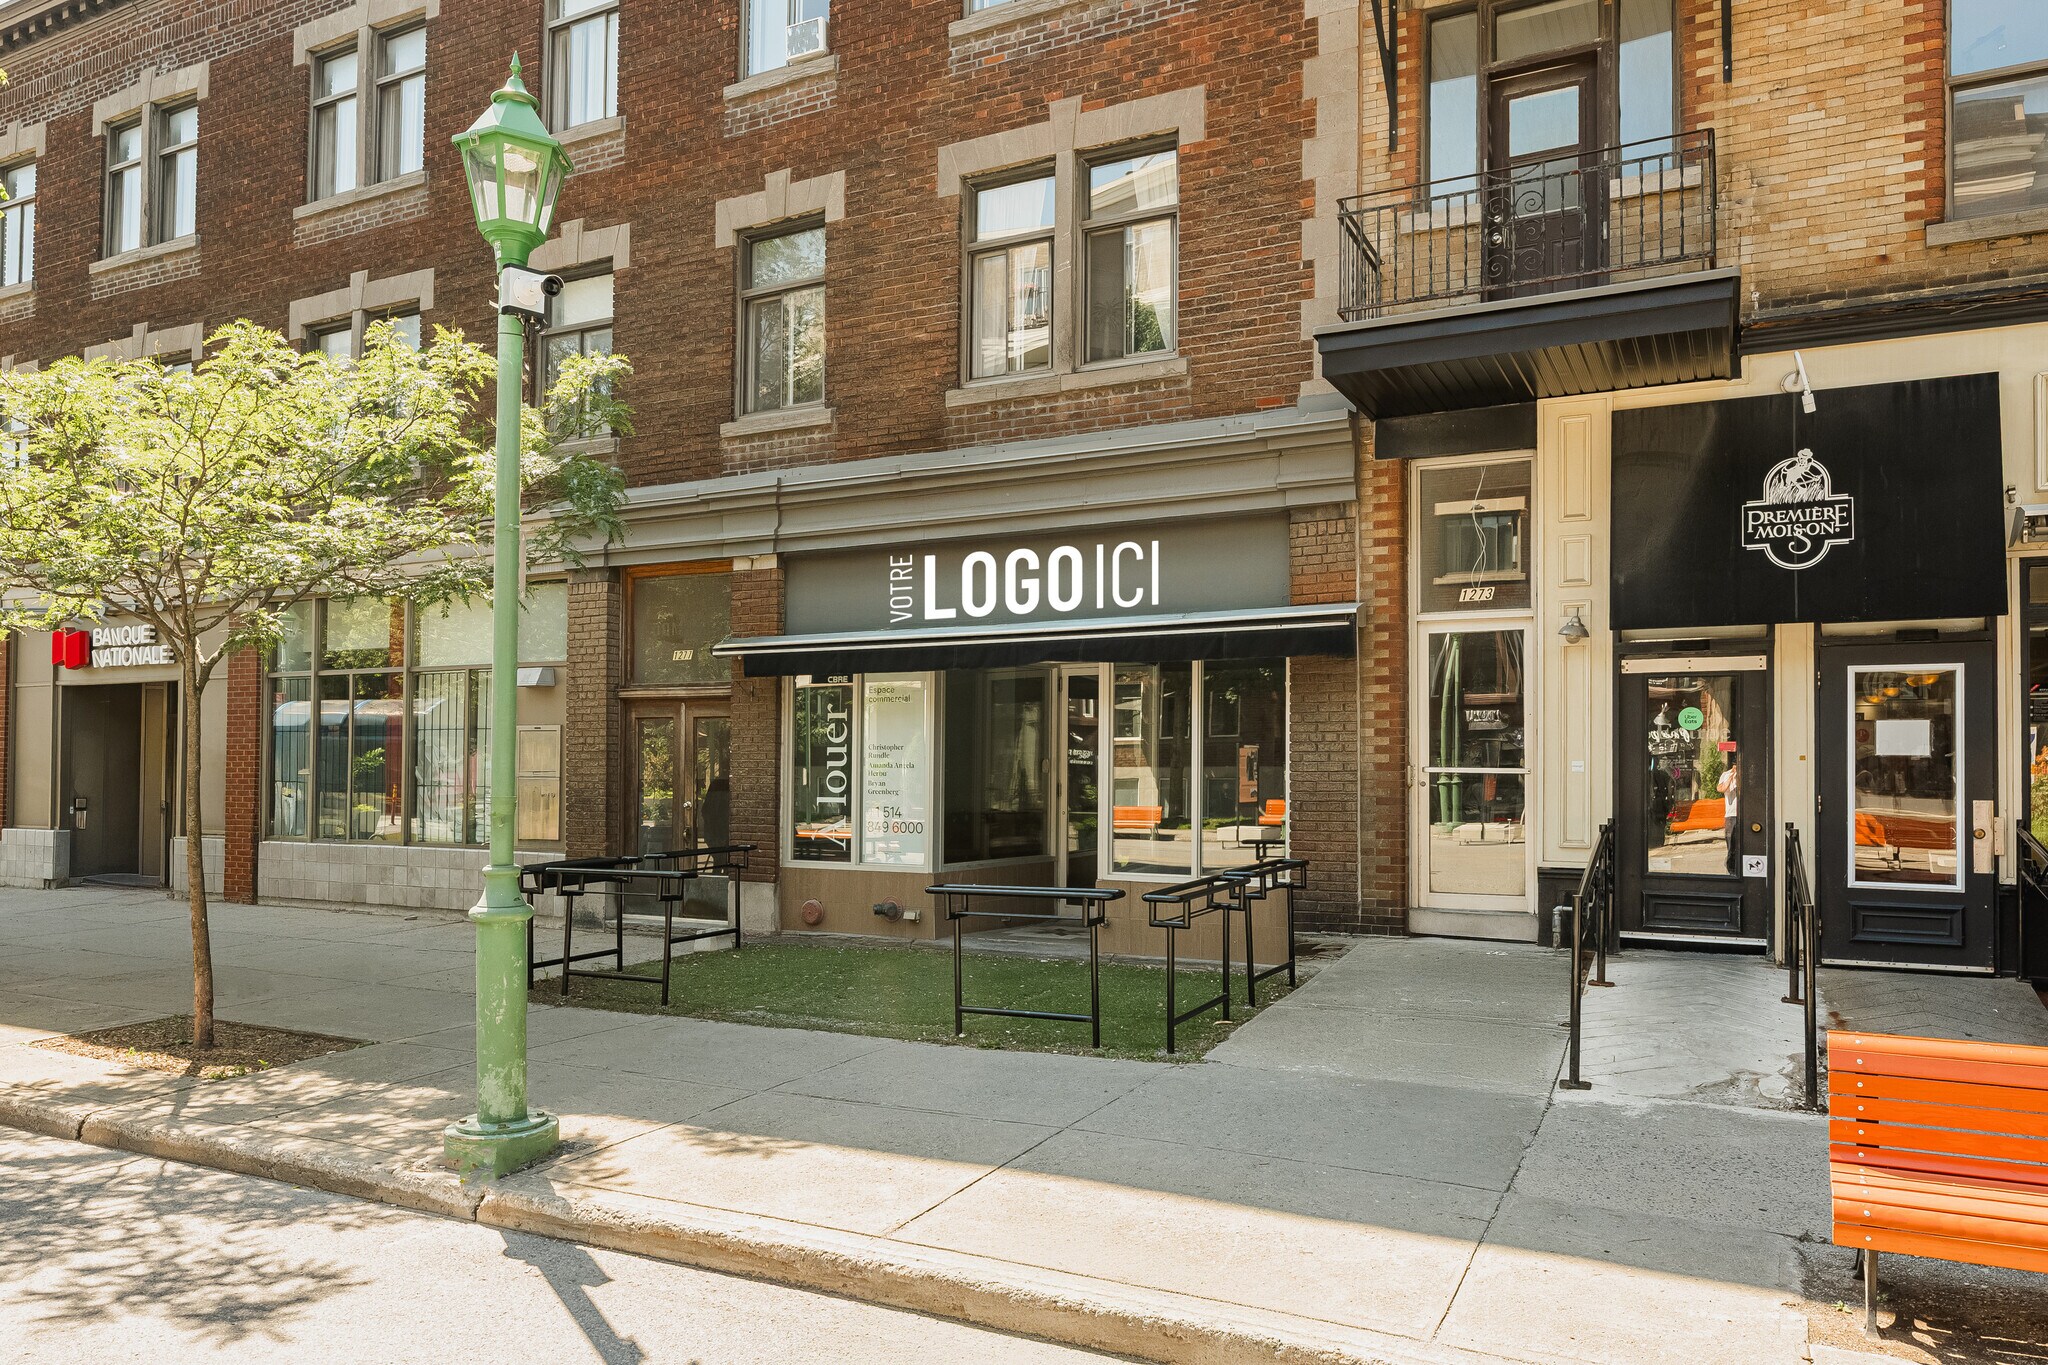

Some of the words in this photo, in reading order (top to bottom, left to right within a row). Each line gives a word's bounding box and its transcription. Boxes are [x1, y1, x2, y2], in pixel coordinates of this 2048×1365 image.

[1747, 504, 1849, 533] PREMIÈRE
[889, 554, 913, 624] VOTRE
[924, 545, 1083, 620] LOGO
[1096, 540, 1160, 609] ICI
[1461, 587, 1494, 602] 1273
[92, 624, 156, 647] BANQUE
[91, 644, 175, 668] NATIONALE
[827, 675, 849, 683] CBRE
[868, 686, 895, 696] Espace
[868, 694, 911, 704] commercial
[816, 703, 848, 806] louer
[868, 743, 904, 752] Christopher
[883, 806, 902, 819] 514
[867, 821, 889, 834] 849
[892, 822, 924, 835] 6000
